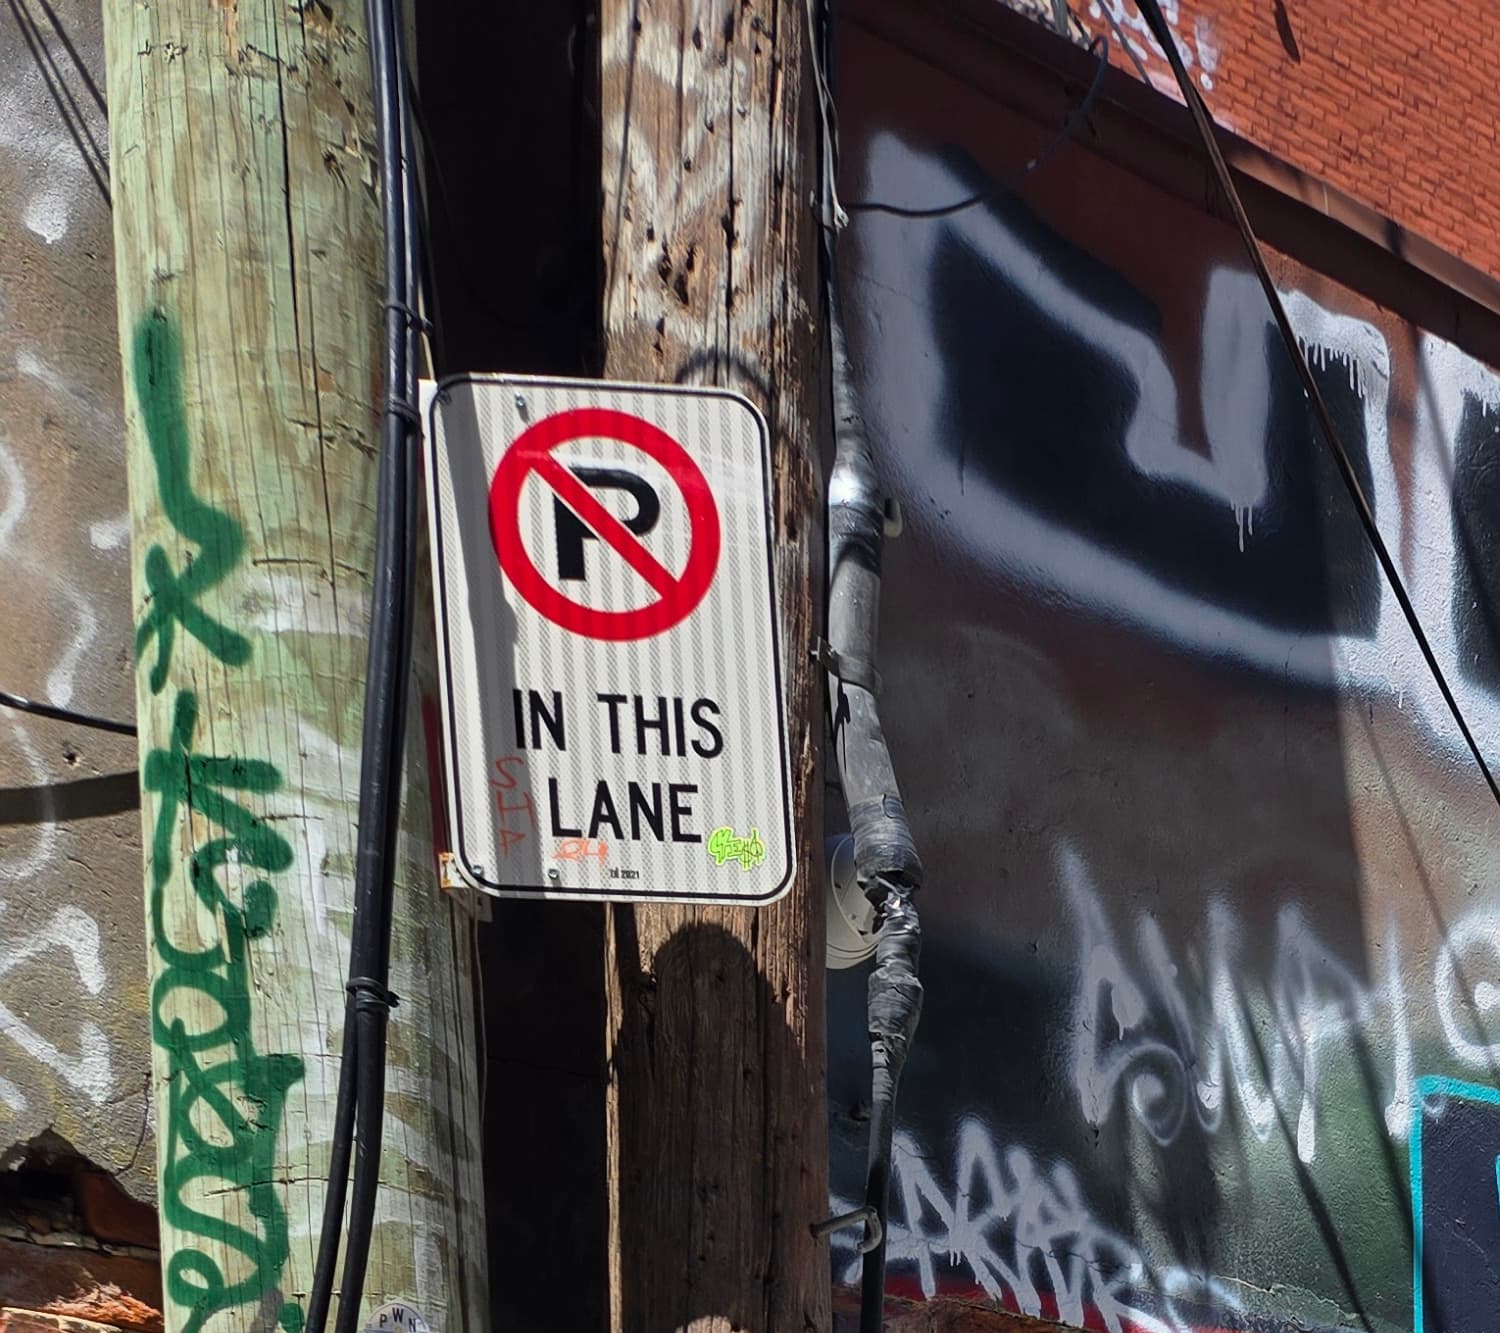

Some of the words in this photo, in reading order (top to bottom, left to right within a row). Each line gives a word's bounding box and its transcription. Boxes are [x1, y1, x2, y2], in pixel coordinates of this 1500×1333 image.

[512, 688, 566, 751] IN
[597, 692, 724, 759] THIS
[549, 777, 702, 844] LANE
